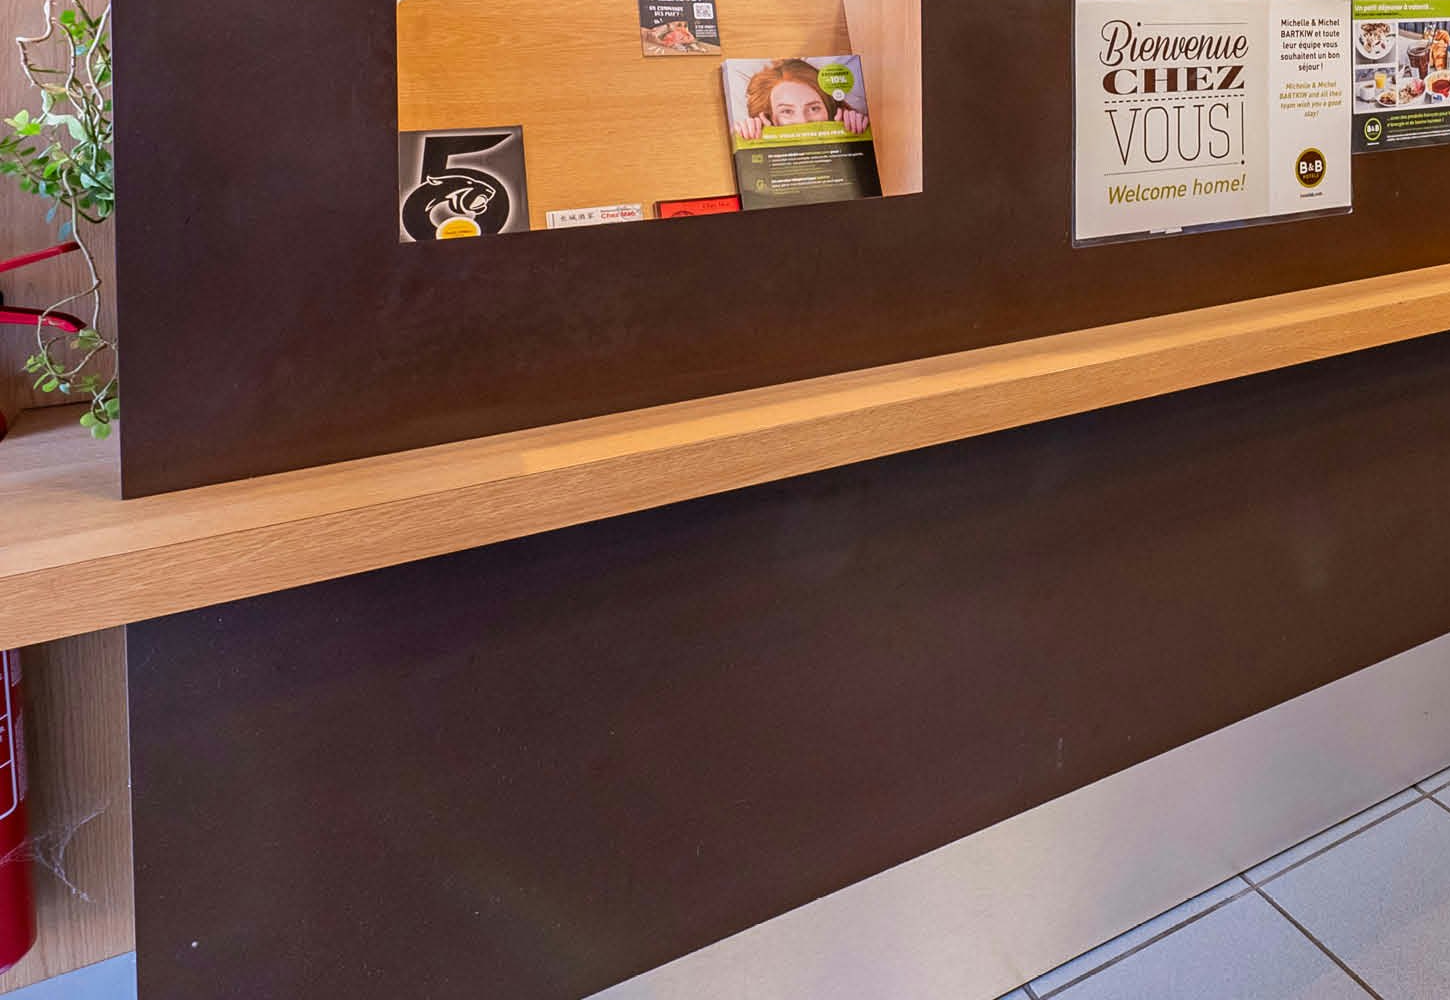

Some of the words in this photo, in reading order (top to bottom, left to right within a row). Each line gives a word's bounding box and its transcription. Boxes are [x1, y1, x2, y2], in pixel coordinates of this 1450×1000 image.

[1281, 18, 1310, 27] Michelle
[1311, 18, 1316, 27] &
[1318, 18, 1340, 26] Michel
[1280, 29, 1313, 38] BARTKIW
[1098, 18, 1249, 67] Bienvenue
[1282, 41, 1297, 49] leur
[1280, 52, 1317, 61] souhaitent
[1327, 51, 1341, 59] bon
[1298, 62, 1320, 72] séjour
[1102, 64, 1246, 96] CHEZ
[1104, 101, 1247, 166] VOUS!
[1300, 159, 1323, 174] B&B
[1107, 181, 1188, 206] Welcome
[1192, 173, 1247, 197] home!
